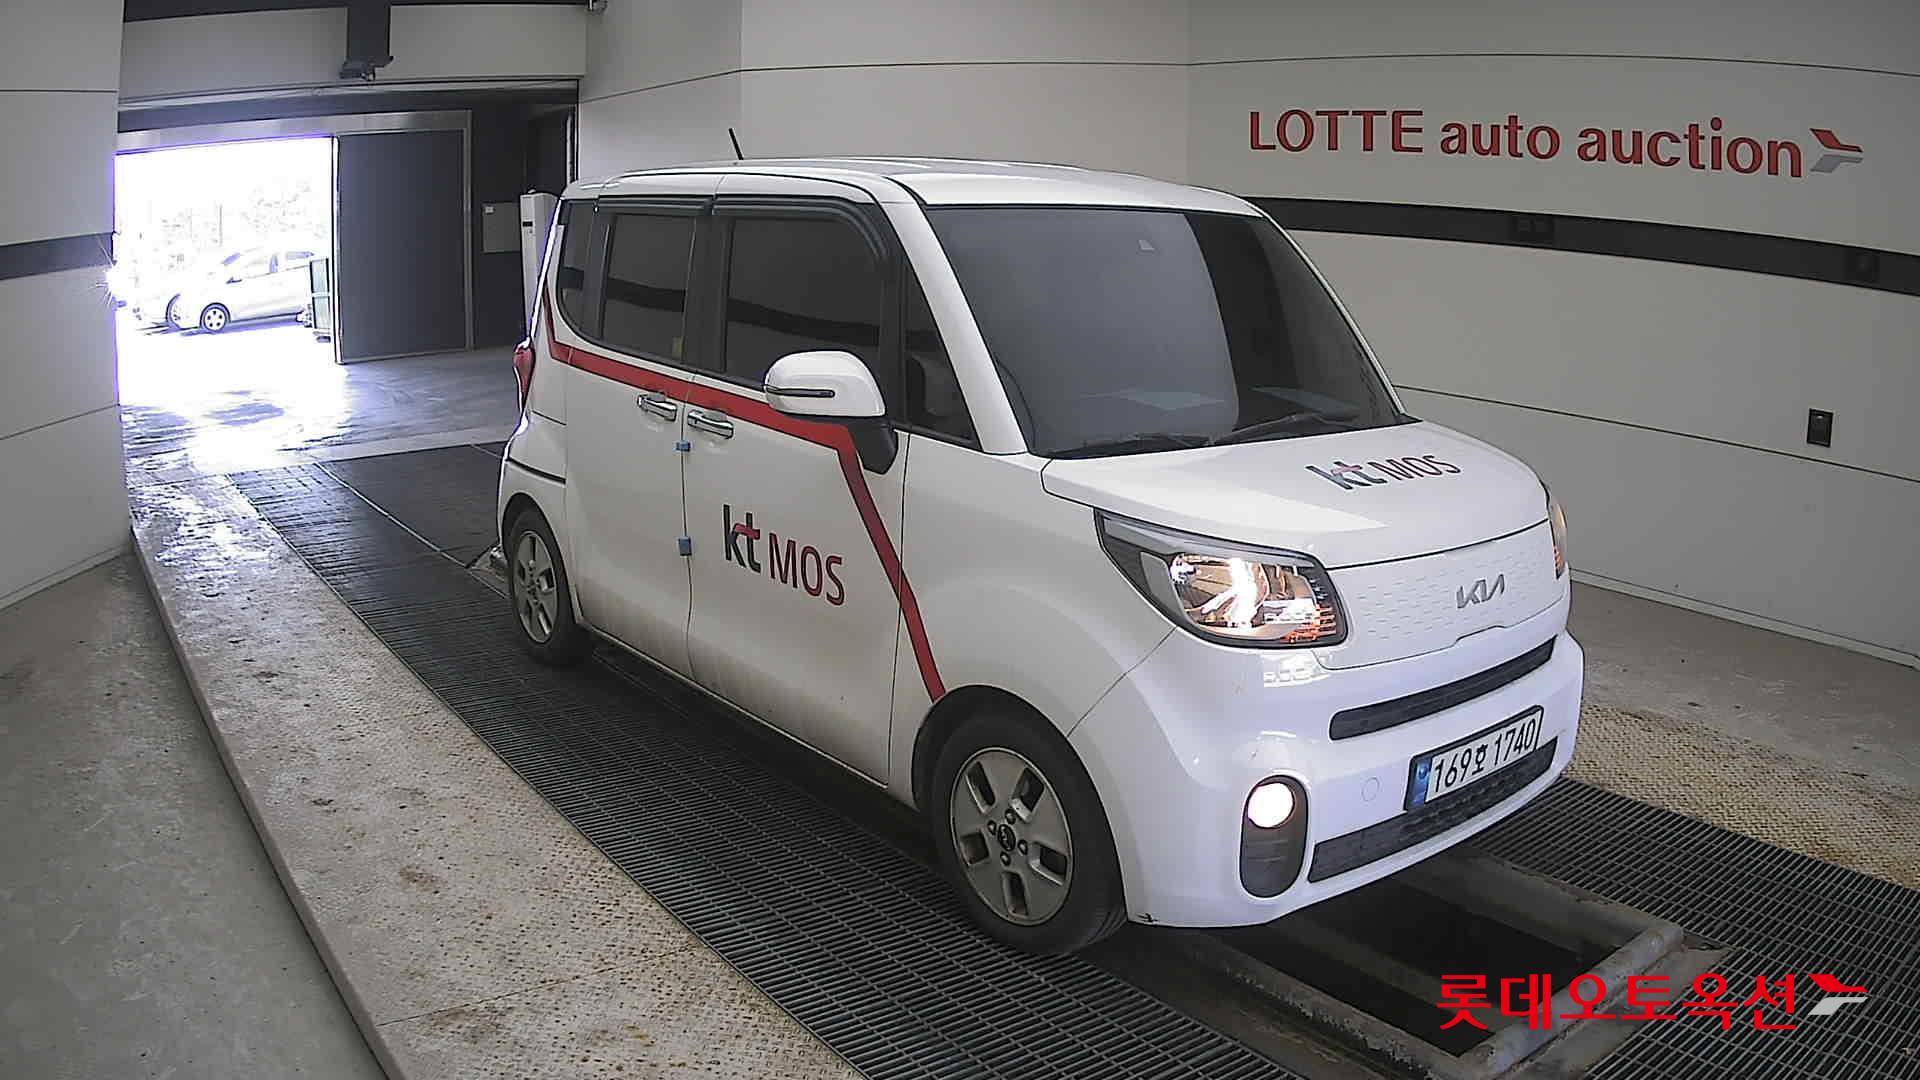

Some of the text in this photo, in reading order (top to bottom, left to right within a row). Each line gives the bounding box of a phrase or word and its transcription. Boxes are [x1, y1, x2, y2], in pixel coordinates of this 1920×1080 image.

[1249, 109, 1803, 179] LOTTE auto auction
[1305, 454, 1461, 490] kt MOS
[722, 503, 846, 607] kt MOS
